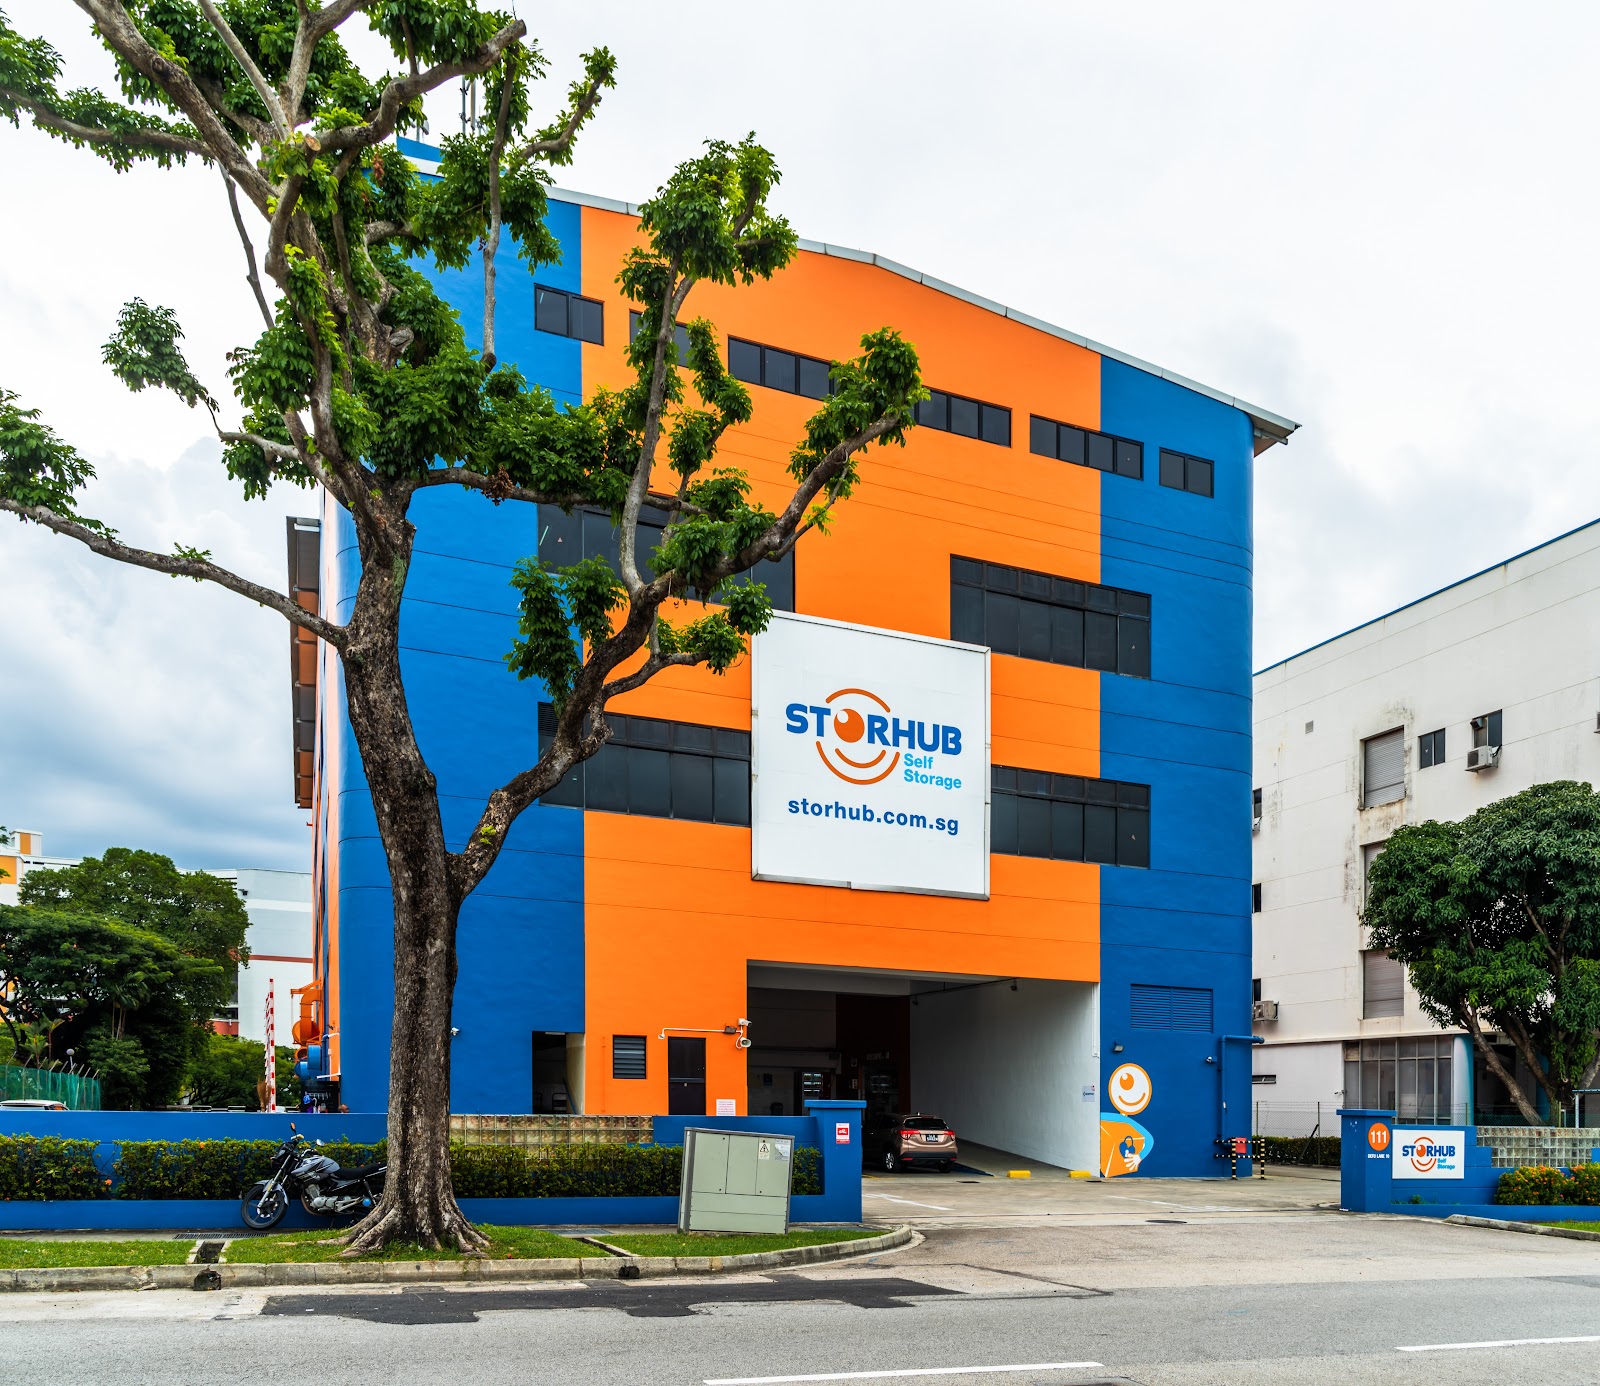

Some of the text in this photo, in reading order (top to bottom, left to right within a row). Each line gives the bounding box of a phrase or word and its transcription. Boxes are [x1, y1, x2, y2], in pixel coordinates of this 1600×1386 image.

[785, 703, 962, 756] STORHUB
[903, 753, 934, 770] Self
[903, 769, 962, 790] Storage
[788, 798, 959, 836] storhub.com.sg
[1371, 1130, 1387, 1144] 111
[1402, 1145, 1456, 1157] STORHUB
